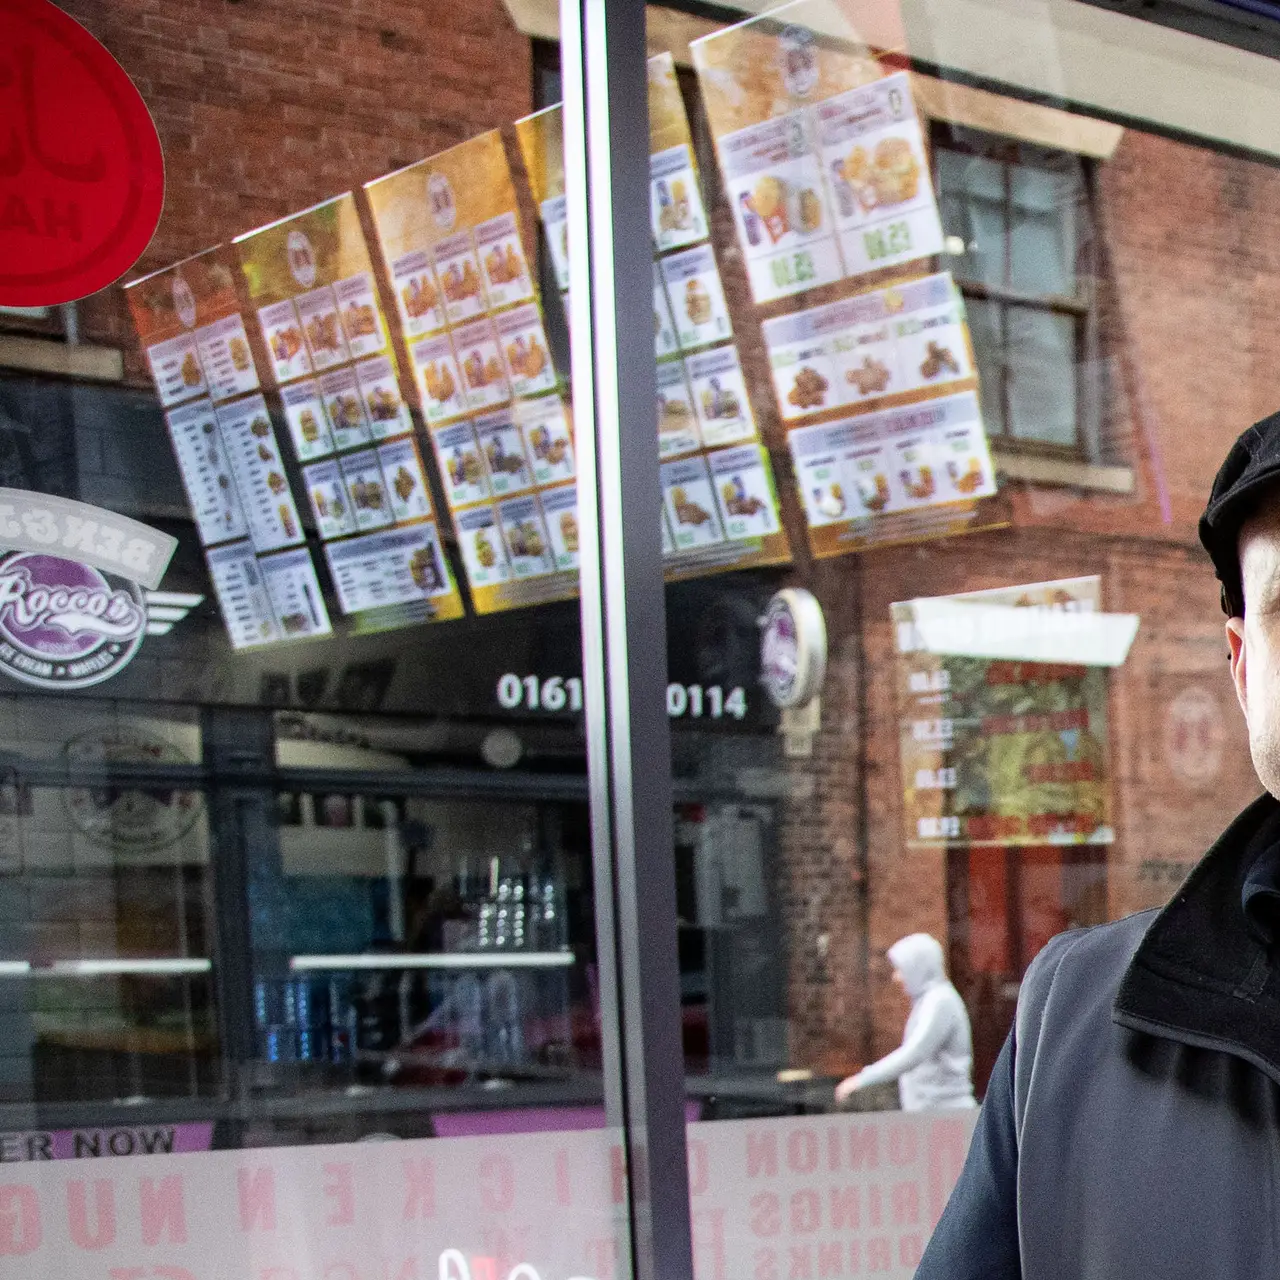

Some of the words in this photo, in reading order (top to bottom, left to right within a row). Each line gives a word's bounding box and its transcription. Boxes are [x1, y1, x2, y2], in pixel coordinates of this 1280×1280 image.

[496, 673, 583, 713] 0161
[666, 683, 748, 721] 0114
[73, 1127, 175, 1158] NOW
